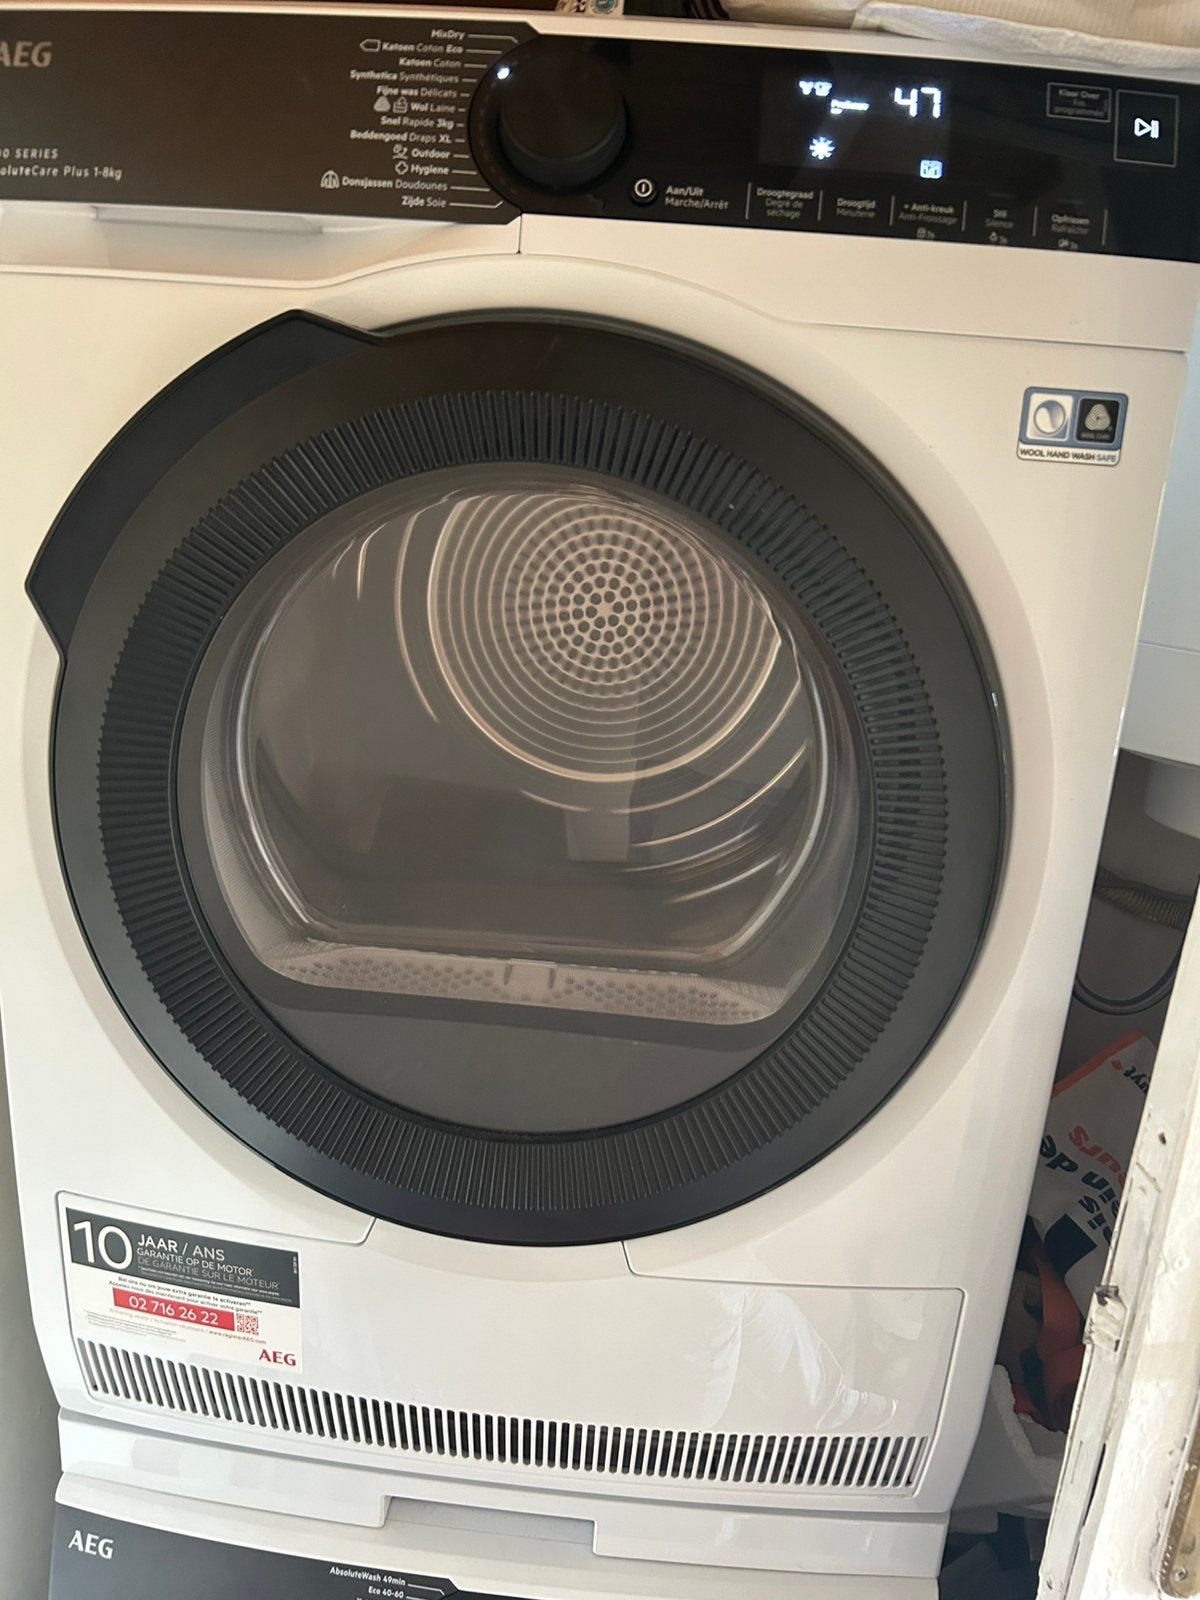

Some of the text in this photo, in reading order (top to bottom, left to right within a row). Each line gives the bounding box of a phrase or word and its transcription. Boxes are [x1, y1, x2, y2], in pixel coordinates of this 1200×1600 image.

[431, 29, 466, 41] MixDry
[0, 41, 53, 68] AEG
[382, 42, 463, 54] Katoen Coton Eco
[399, 57, 461, 68] Katoen Coton
[350, 69, 398, 82] Synthetica
[376, 85, 399, 97] Fijne
[400, 88, 419, 97] was
[410, 102, 456, 113] Wol Laine
[894, 87, 942, 118] 47
[381, 116, 454, 130] Snel Rapide 3kg
[350, 130, 452, 144] Beddengoed Draps XL
[0, 147, 59, 160] 0 SERIES
[411, 148, 451, 159] Outdoor
[63, 165, 89, 177] Plus
[94, 166, 122, 181] 1-8kg
[410, 164, 450, 176] Hygiene
[342, 177, 449, 192] Donsjassen Doudounes
[665, 185, 705, 197] Aan/Uit
[756, 187, 814, 201] Droogtegraad
[401, 195, 447, 208] Zijde Soie
[665, 196, 729, 210] Marche/Arrêt
[1020, 448, 1117, 463] WOOL HAND WASH SAFE
[73, 1219, 133, 1270] 10
[137, 1233, 178, 1253] JAAR
[192, 1244, 226, 1262] ANS
[136, 1247, 183, 1265] GARANTIE
[185, 1256, 201, 1268] OP
[201, 1259, 215, 1271] DE
[137, 1255, 153, 1268] DE
[153, 1258, 200, 1276] GARANTIE
[201, 1268, 221, 1280] SUR
[222, 1272, 235, 1283] LE
[129, 1295, 148, 1311] 02
[150, 1300, 175, 1317] 716
[179, 1306, 197, 1321] 26
[201, 1310, 219, 1326] 22
[258, 1348, 297, 1367] AEG
[68, 1529, 114, 1560] AEG
[329, 1566, 406, 1586] AbsoluteWash 49min
[368, 1586, 405, 1599] Eco 40-60
